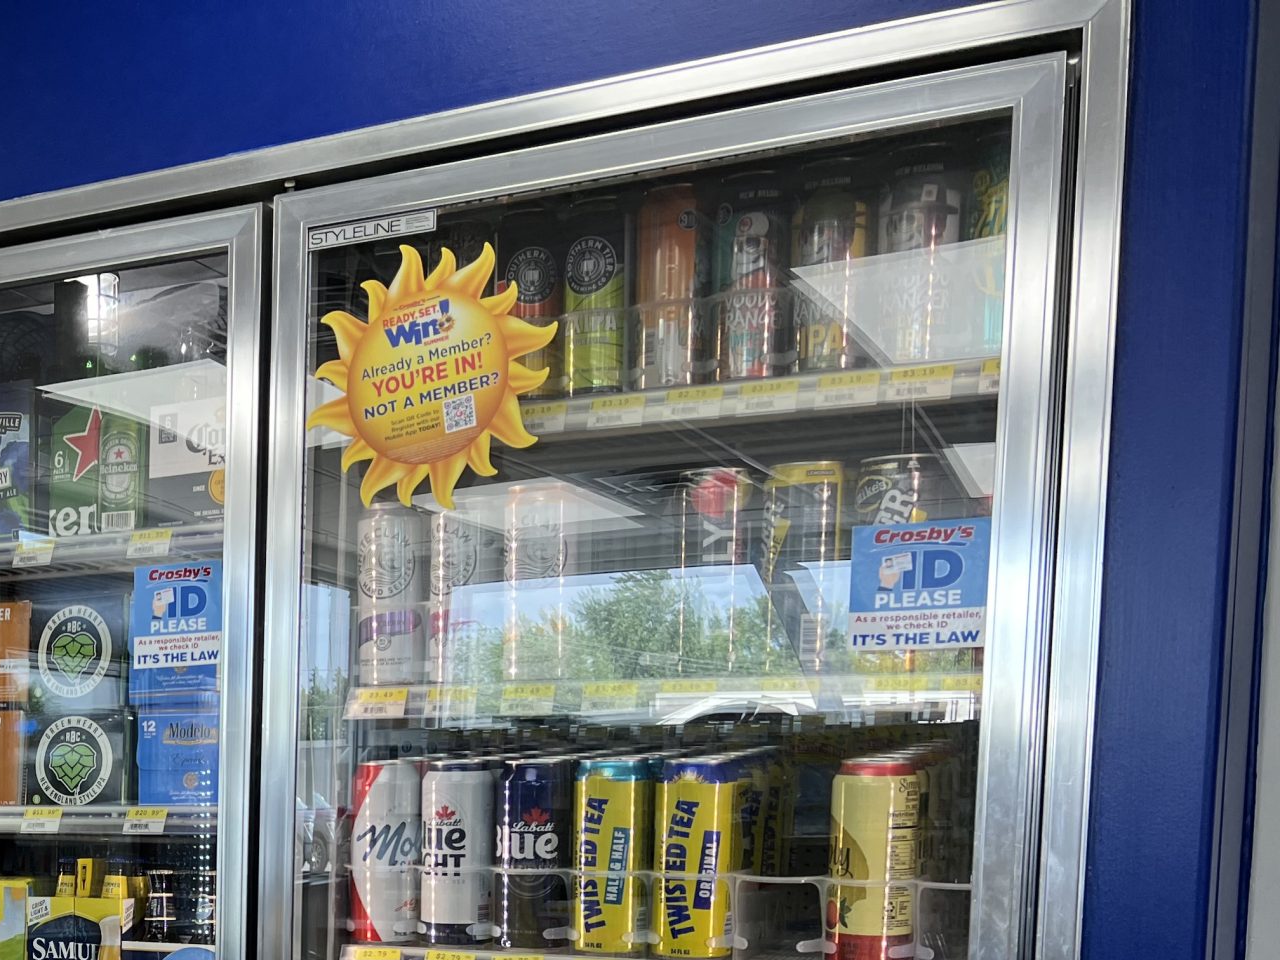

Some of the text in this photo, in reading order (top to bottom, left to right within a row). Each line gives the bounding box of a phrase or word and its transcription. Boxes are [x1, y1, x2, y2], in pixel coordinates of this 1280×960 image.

[311, 219, 401, 246] STYLELINE
[362, 333, 492, 381] Already a Member?
[372, 352, 483, 397] YOU'RE IN!
[364, 372, 499, 419] NOT A MEMBER?
[54, 451, 63, 468] 6
[874, 525, 975, 544] Crosby's
[148, 567, 211, 582] Crosby's
[875, 590, 961, 609] PLEASE
[879, 612, 939, 624] responsible
[942, 611, 982, 622] retailer,
[904, 621, 932, 630] check
[150, 619, 206, 633] PLEASE
[852, 630, 980, 646] IT'S THE LAW
[137, 650, 219, 665] IT'S THE LAW
[142, 721, 156, 732] 12
[169, 723, 211, 740] Modelo
[511, 822, 554, 832] Labatt
